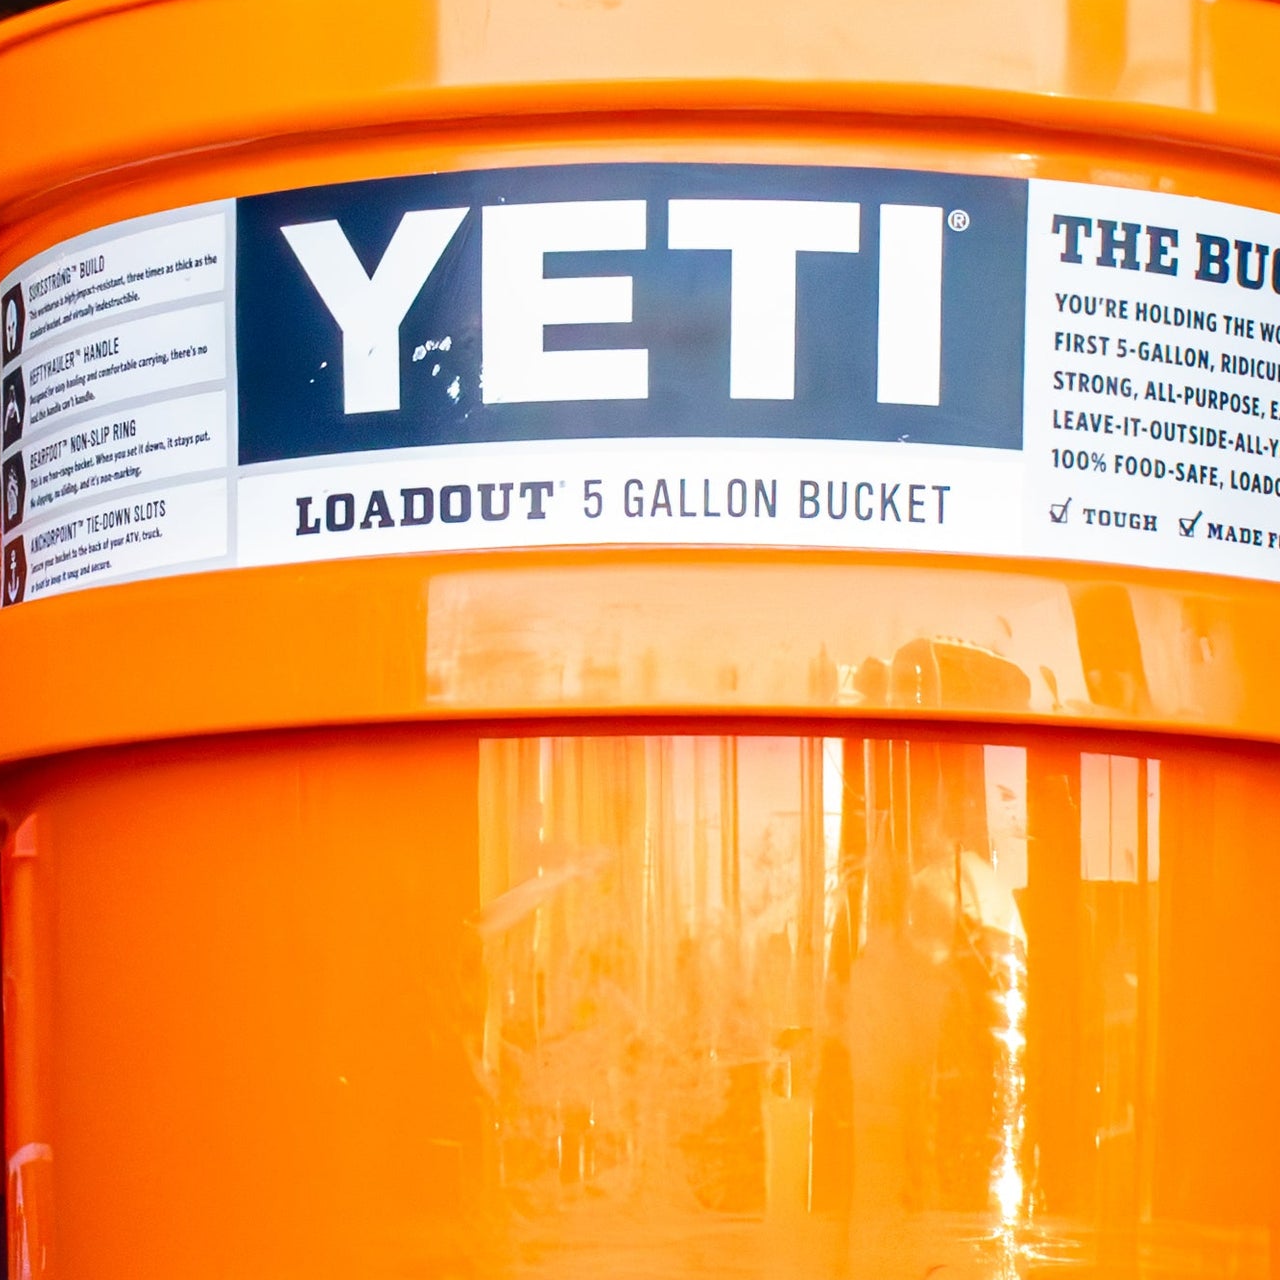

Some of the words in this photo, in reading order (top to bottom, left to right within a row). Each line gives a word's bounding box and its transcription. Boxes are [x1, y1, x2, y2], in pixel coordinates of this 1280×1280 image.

[1051, 214, 1178, 276] THE
[80, 255, 104, 279] BUILD
[127, 271, 144, 283] three
[145, 267, 164, 279] times
[167, 263, 173, 273] as
[176, 258, 193, 271] thick
[195, 258, 202, 267] as
[205, 254, 217, 265] the
[1056, 294, 1128, 320] YOU'RE
[1136, 302, 1217, 332] HOLDING
[1224, 316, 1255, 339] THE
[84, 338, 119, 363] HANDLE
[87, 370, 97, 381] and
[98, 359, 137, 379] comfortable
[138, 352, 169, 368] carrying,
[171, 345, 196, 360] there's
[198, 345, 207, 355] no
[1055, 333, 1109, 356] FIRST
[1116, 339, 1215, 373] 5-GALLON,
[1053, 371, 1138, 401] STRONG,
[1144, 381, 1265, 420] ALL-PURPOSE,
[70, 426, 109, 453] NON-SLIP
[113, 419, 136, 441] RING
[96, 453, 113, 465] When
[114, 449, 126, 463] you
[127, 447, 137, 457] set
[138, 444, 144, 455] it
[145, 441, 166, 453] down,
[167, 437, 173, 448] it
[175, 436, 194, 450] stays
[195, 430, 210, 444] put.
[1051, 448, 1107, 473] 100%
[1115, 456, 1224, 490] FOOD-SAFE,
[87, 507, 130, 534] TIE-DOWN
[134, 500, 166, 522] SLOTS
[583, 480, 603, 519] 5
[623, 479, 777, 519] GALLON
[799, 480, 951, 524] BUCKET
[89, 541, 101, 554] back
[103, 538, 109, 550] of
[110, 536, 125, 550] your
[125, 531, 141, 545] ATV,
[143, 527, 162, 541] truck,
[1083, 508, 1158, 532] TOUGH
[1208, 523, 1262, 547] MADE
